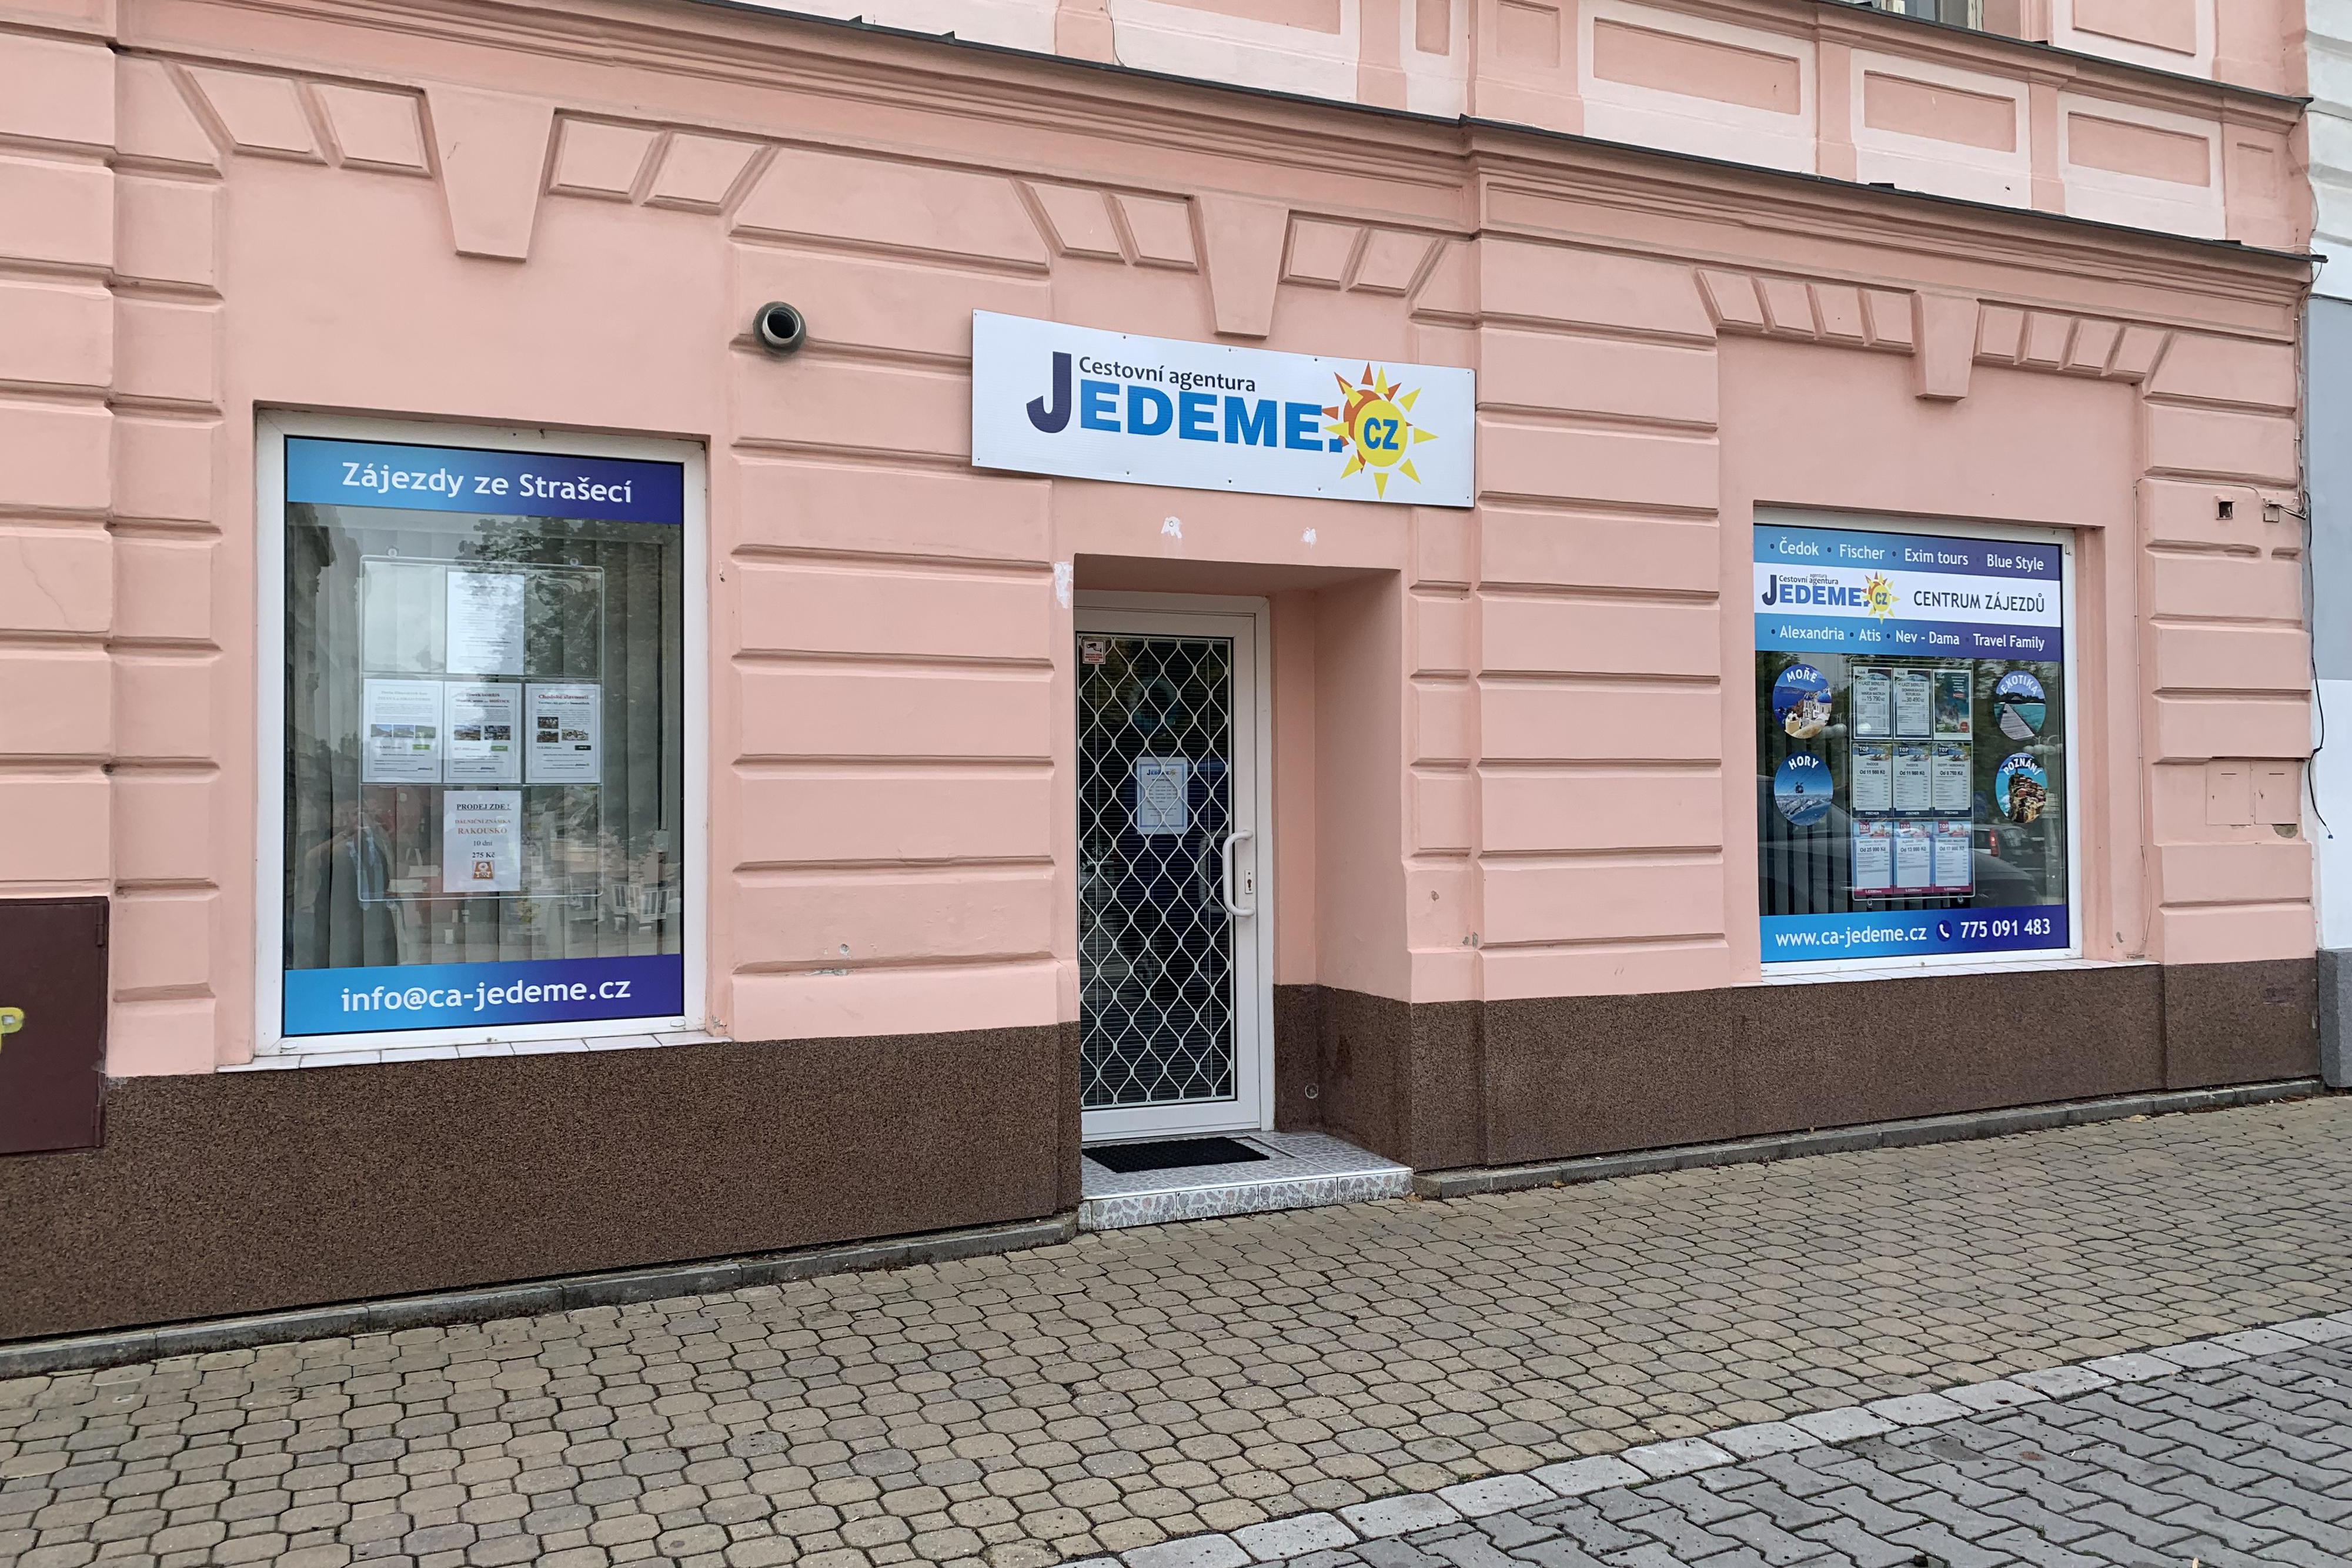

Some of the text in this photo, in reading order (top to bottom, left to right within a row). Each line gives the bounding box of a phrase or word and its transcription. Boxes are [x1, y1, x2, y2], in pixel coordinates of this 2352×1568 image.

[1078, 356, 1257, 392] Cestovní agentura
[342, 462, 632, 503] Zájezdy ze Strašecí
[1779, 536, 2044, 573] Čedok Fischer Exim tours Blue Style
[1779, 575, 1839, 586] Cestovní agentura
[1913, 590, 2045, 613] CENTRUM ZÁJEZDŮ
[1779, 624, 1845, 641] Alexandria
[1859, 627, 1881, 642] Atis
[1895, 630, 1917, 644] Nev
[1929, 631, 1960, 645] Dama
[1973, 632, 2006, 647] Travel
[2009, 634, 2045, 651] Family
[1786, 667, 1818, 683] MOŘE
[1788, 755, 1819, 770] HORY
[457, 827, 507, 835] RAKOUSKO
[1775, 917, 2050, 948] www.ca-jedeme.cz 775 091 483
[340, 979, 632, 1012] info@ca-jedeme.cz
